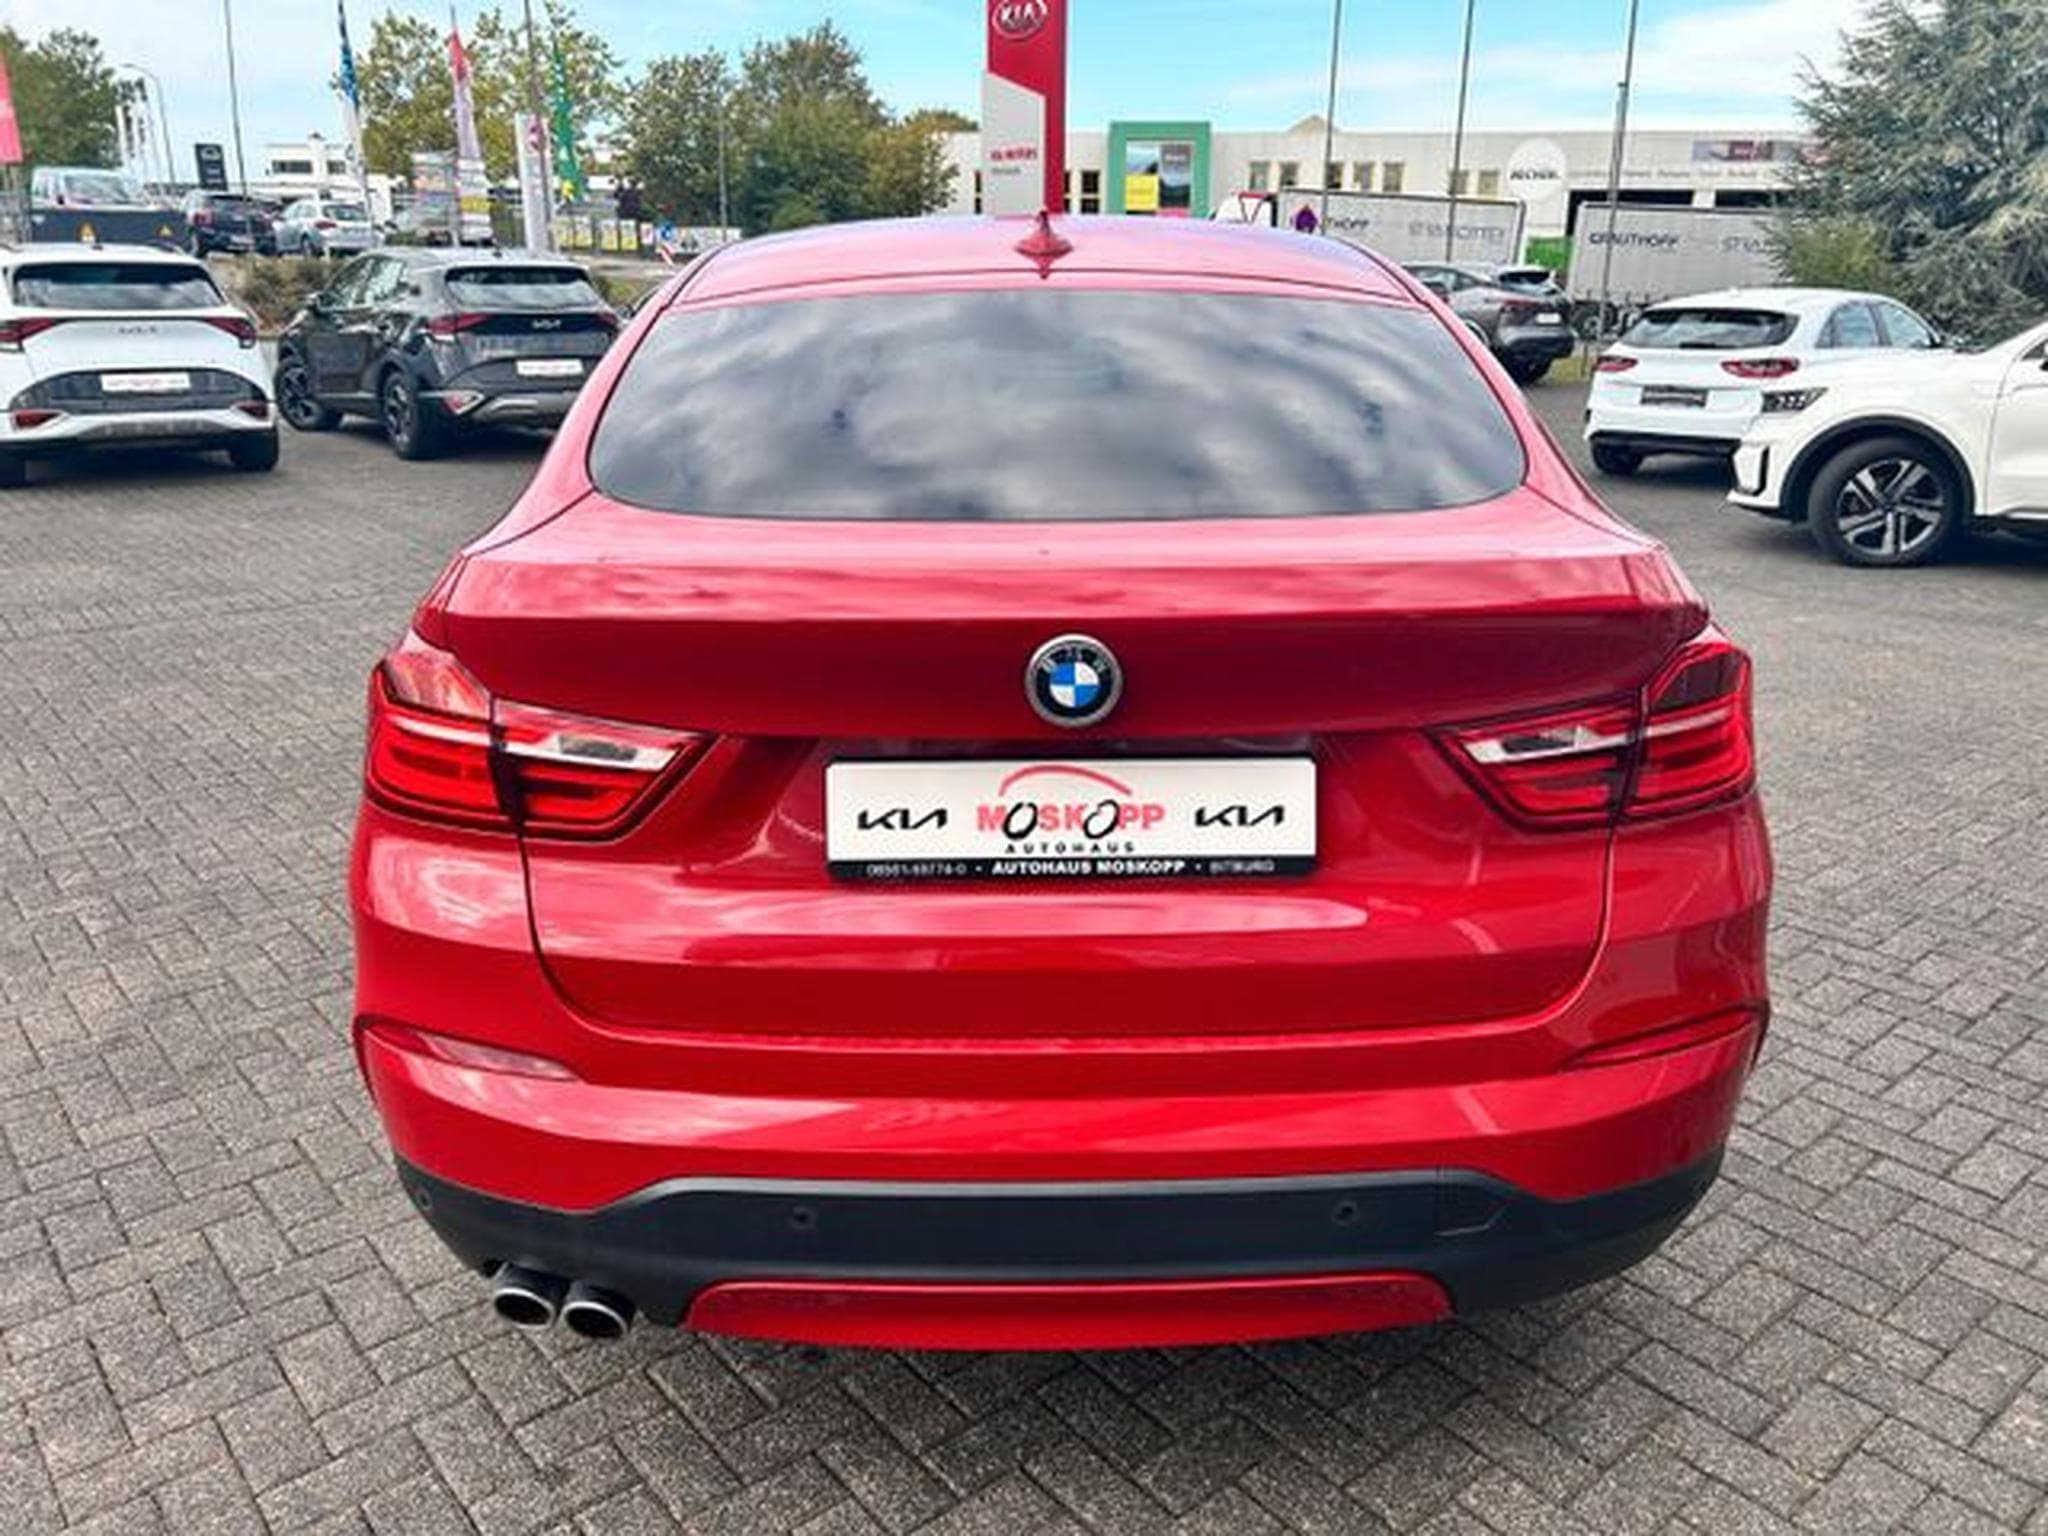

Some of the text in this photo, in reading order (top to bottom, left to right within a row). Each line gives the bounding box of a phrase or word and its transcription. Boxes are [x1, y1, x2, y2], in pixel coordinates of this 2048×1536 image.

[1000, 2, 1038, 23] KIA
[857, 807, 948, 830] KIA
[976, 799, 1165, 840] MOSKOPP
[1195, 804, 1284, 827] KIA
[1004, 842, 1135, 854] AUTOHAUS
[991, 860, 1091, 875] AUTOHAUS
[1096, 859, 1186, 874] MOSKOPP
